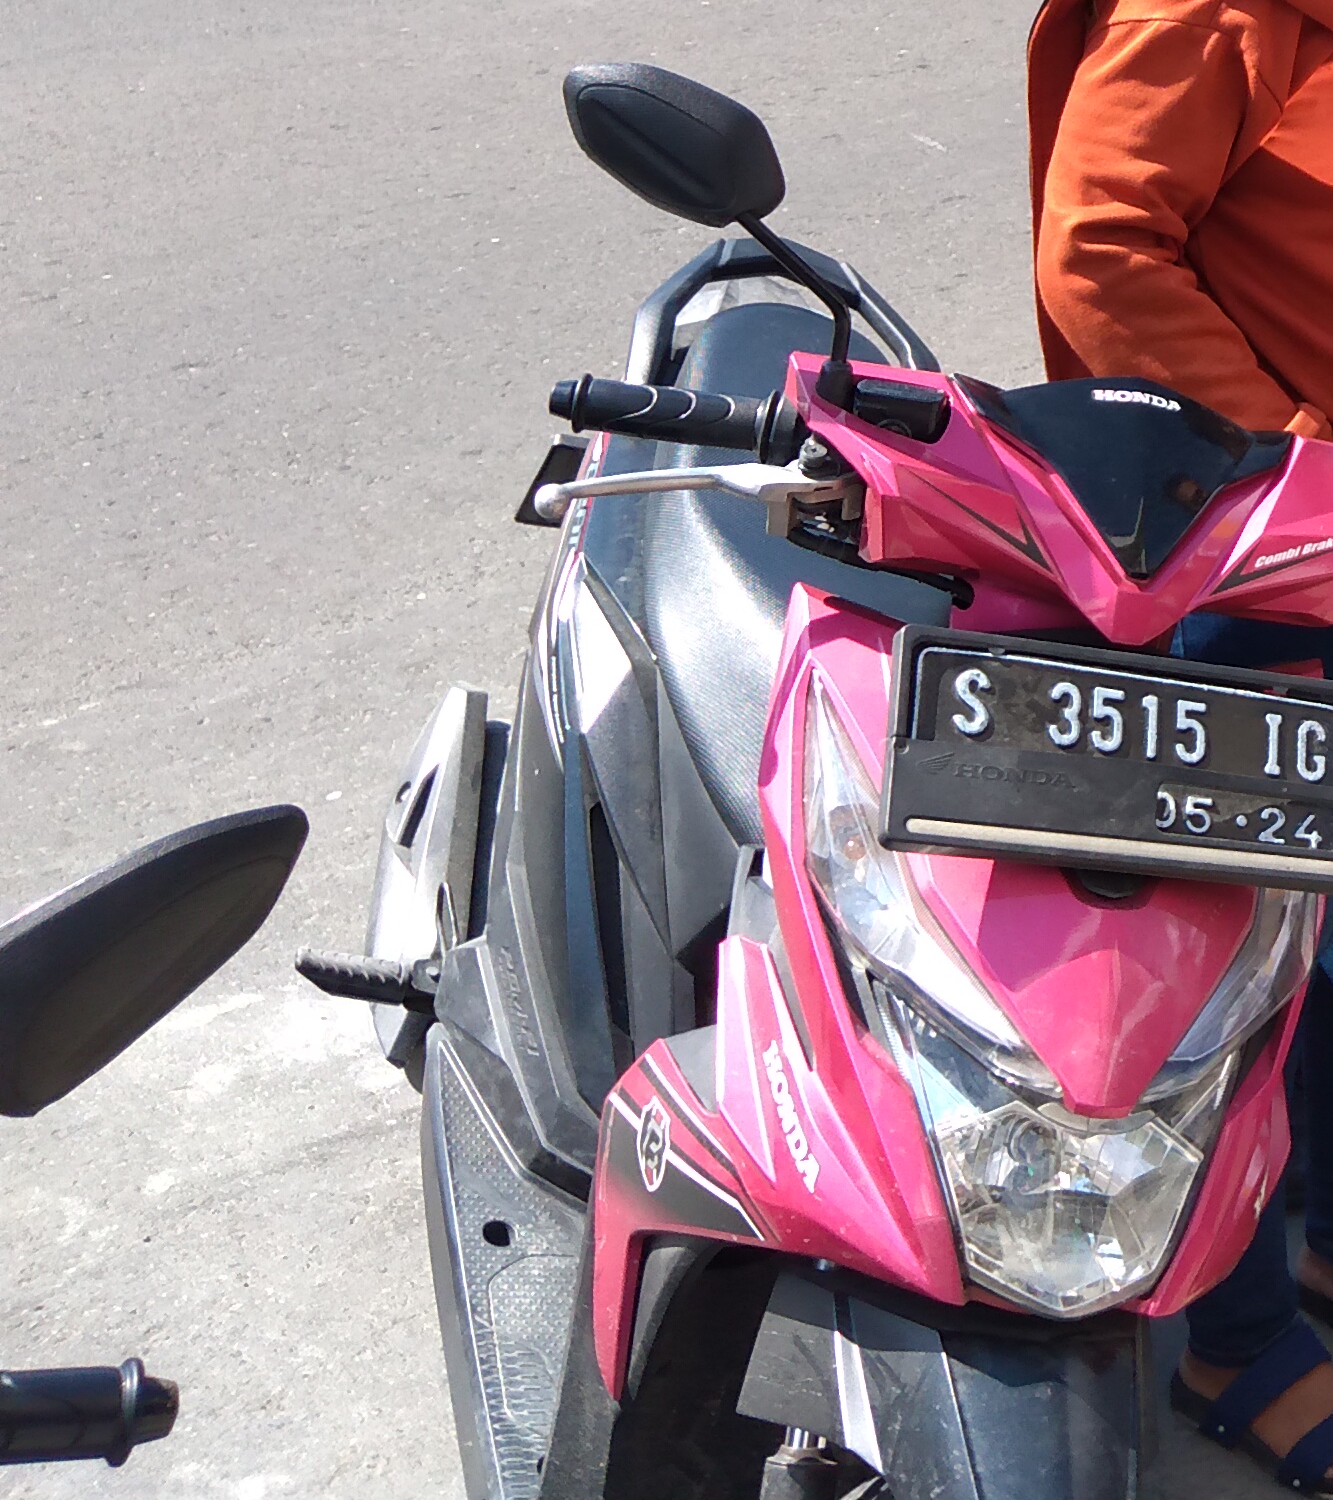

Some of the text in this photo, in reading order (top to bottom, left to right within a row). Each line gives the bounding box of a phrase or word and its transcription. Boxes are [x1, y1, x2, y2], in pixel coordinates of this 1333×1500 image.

[1092, 389, 1182, 412] HONDA
[1254, 545, 1302, 569] Combi
[952, 668, 1327, 782] S 3515 IG
[953, 762, 1076, 789] HONDA
[763, 1040, 820, 1194] HONDA
